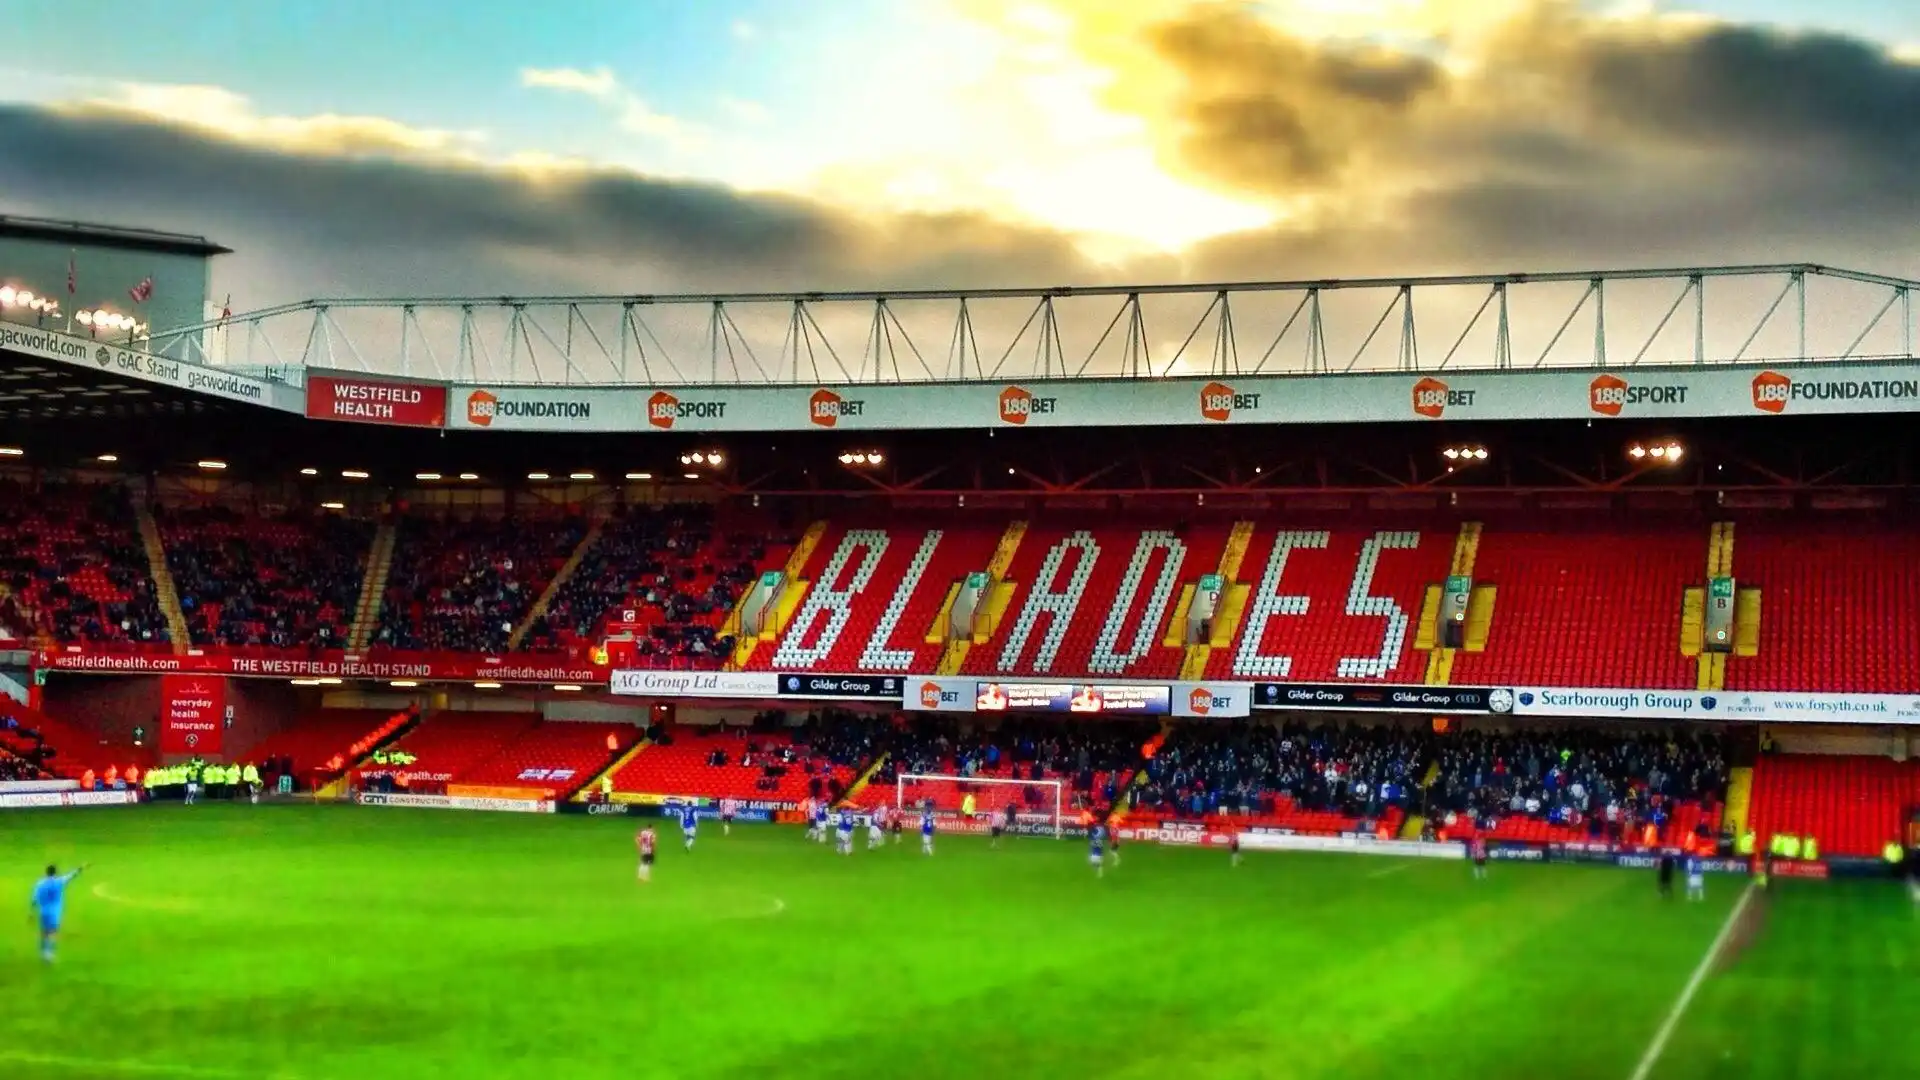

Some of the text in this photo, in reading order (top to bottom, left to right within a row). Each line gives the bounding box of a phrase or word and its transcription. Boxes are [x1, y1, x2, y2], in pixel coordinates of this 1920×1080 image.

[117, 351, 179, 380] GAC Stand
[188, 371, 261, 399] gacworld.com
[334, 384, 421, 403] WESTFIELD
[334, 402, 393, 418] HEALTH
[1717, 598, 1727, 609] B
[624, 611, 634, 621] G
[55, 656, 180, 669] westfieldhealth.com
[232, 658, 431, 677] THE WESTFIELD HEALTH STAND
[476, 667, 594, 681] westfieldhealth.com
[619, 674, 718, 692] AG Group Ltd
[810, 679, 870, 692] Gilder Group
[1287, 689, 1314, 700] Gilder
[1316, 690, 1344, 703] Group
[1392, 692, 1420, 703] Gilder
[1421, 692, 1451, 705] Group
[1541, 690, 1693, 711] Scarborough Group
[171, 699, 212, 709] everyday
[171, 709, 200, 719] health
[170, 721, 215, 731] insurance
[588, 803, 628, 815] CARLING
[1135, 828, 1208, 843] npower
